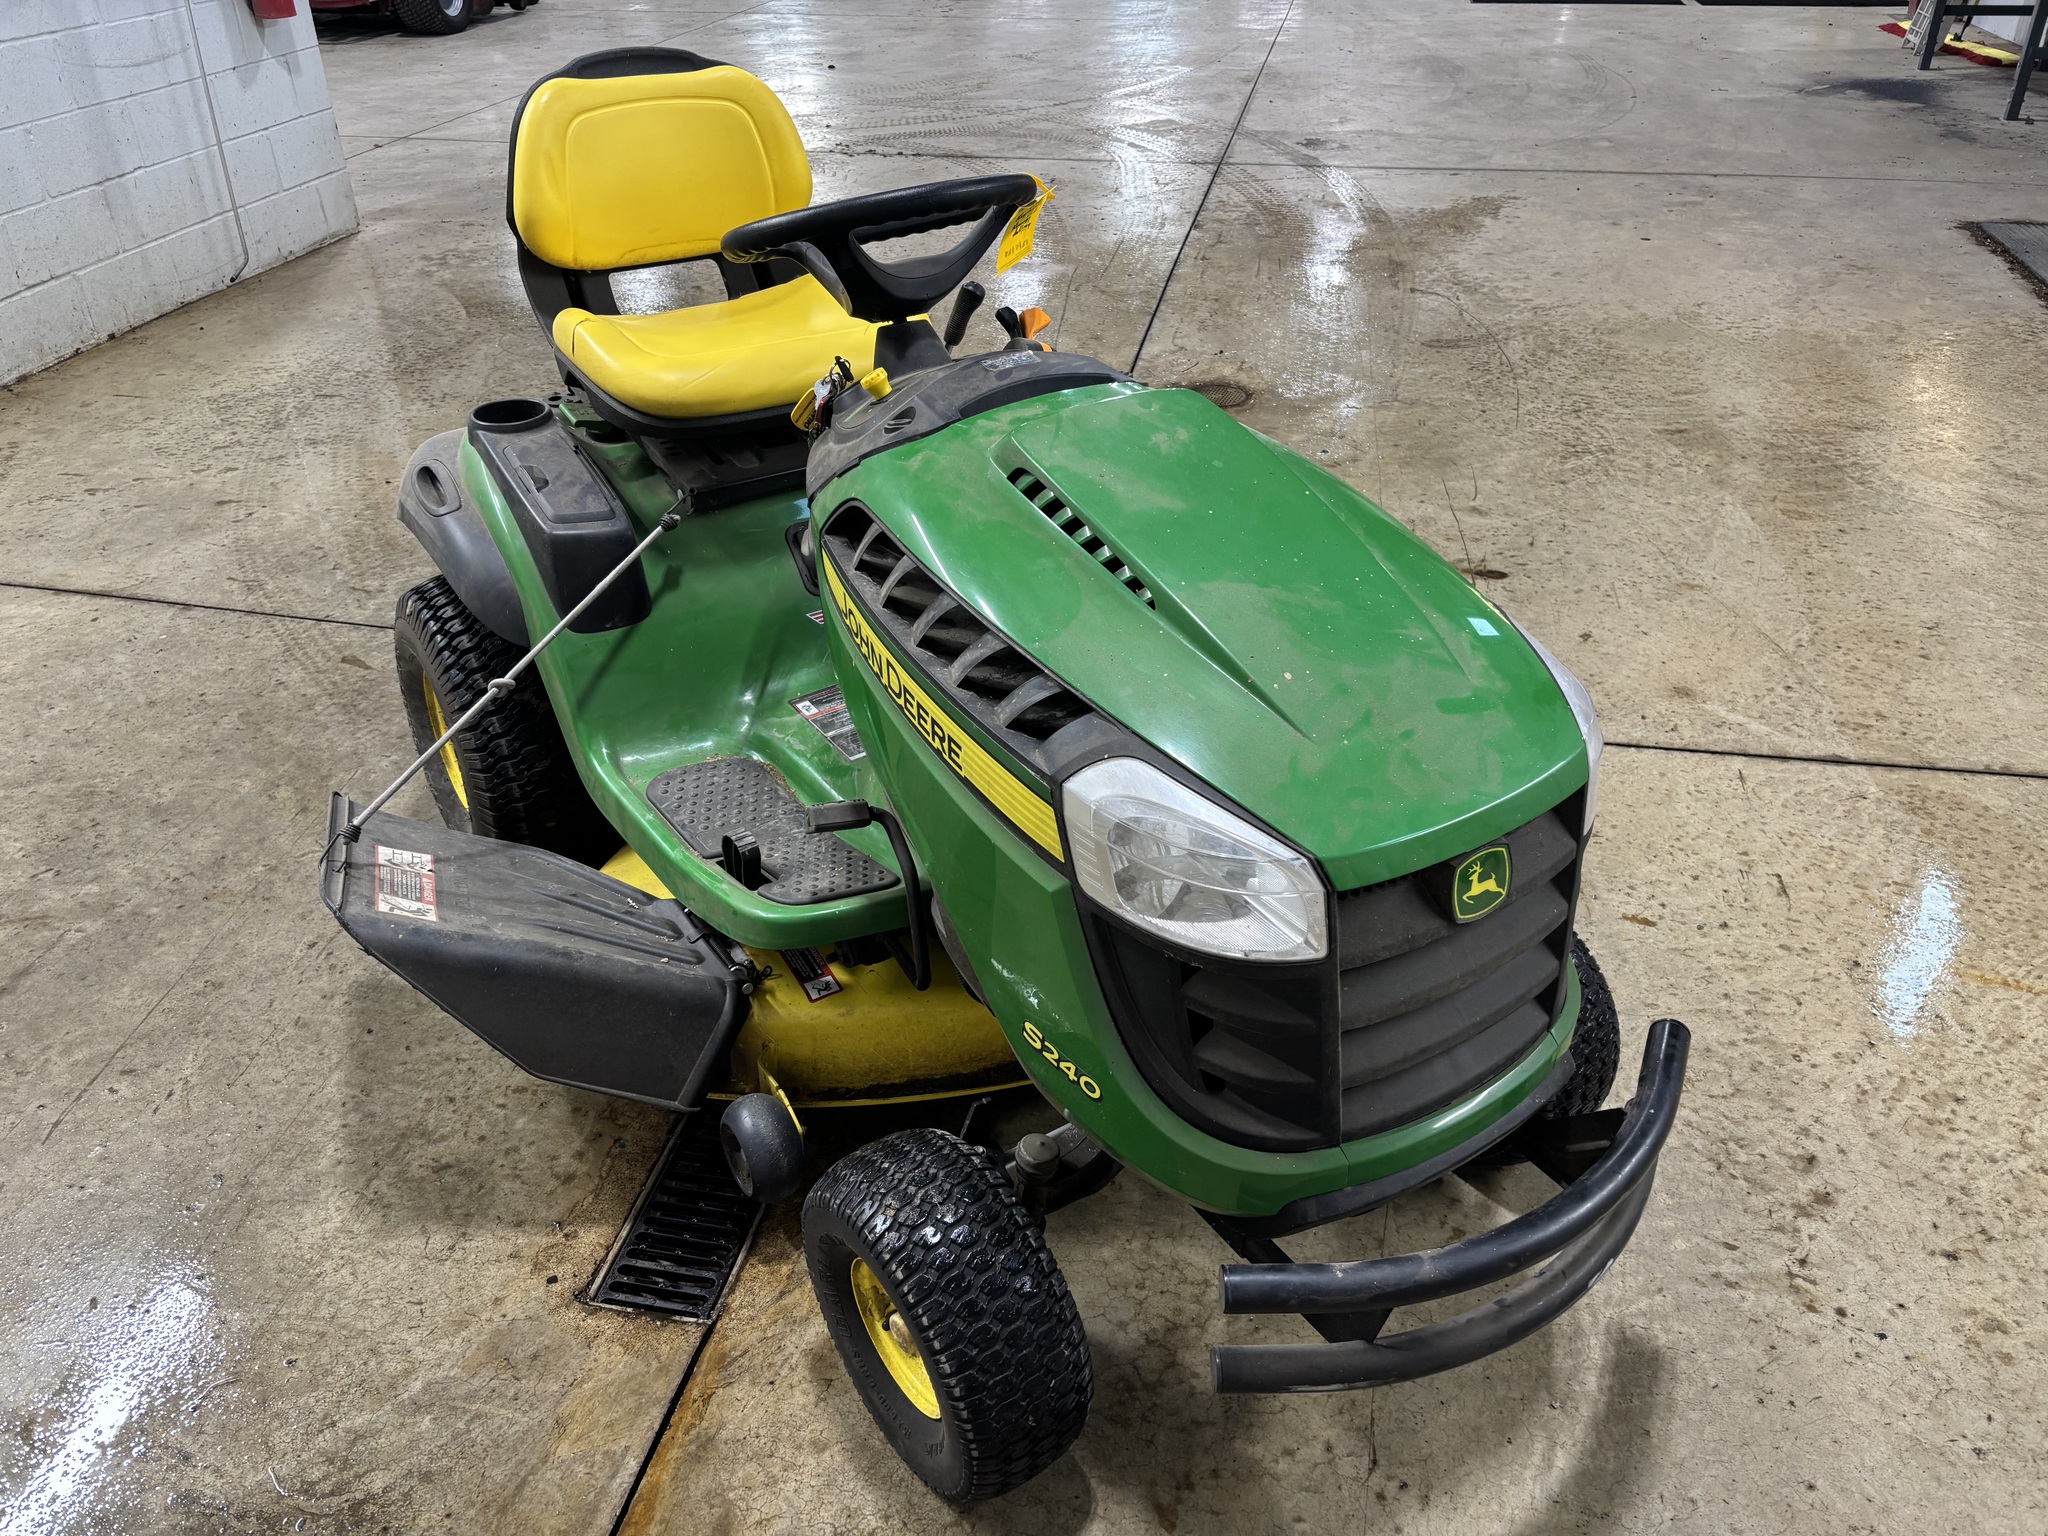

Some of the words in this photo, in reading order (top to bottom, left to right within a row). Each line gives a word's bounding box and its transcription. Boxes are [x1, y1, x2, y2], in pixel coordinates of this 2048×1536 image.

[840, 590, 884, 680] JOHN
[887, 661, 963, 773] DEERE
[1023, 1020, 1102, 1100] S240
